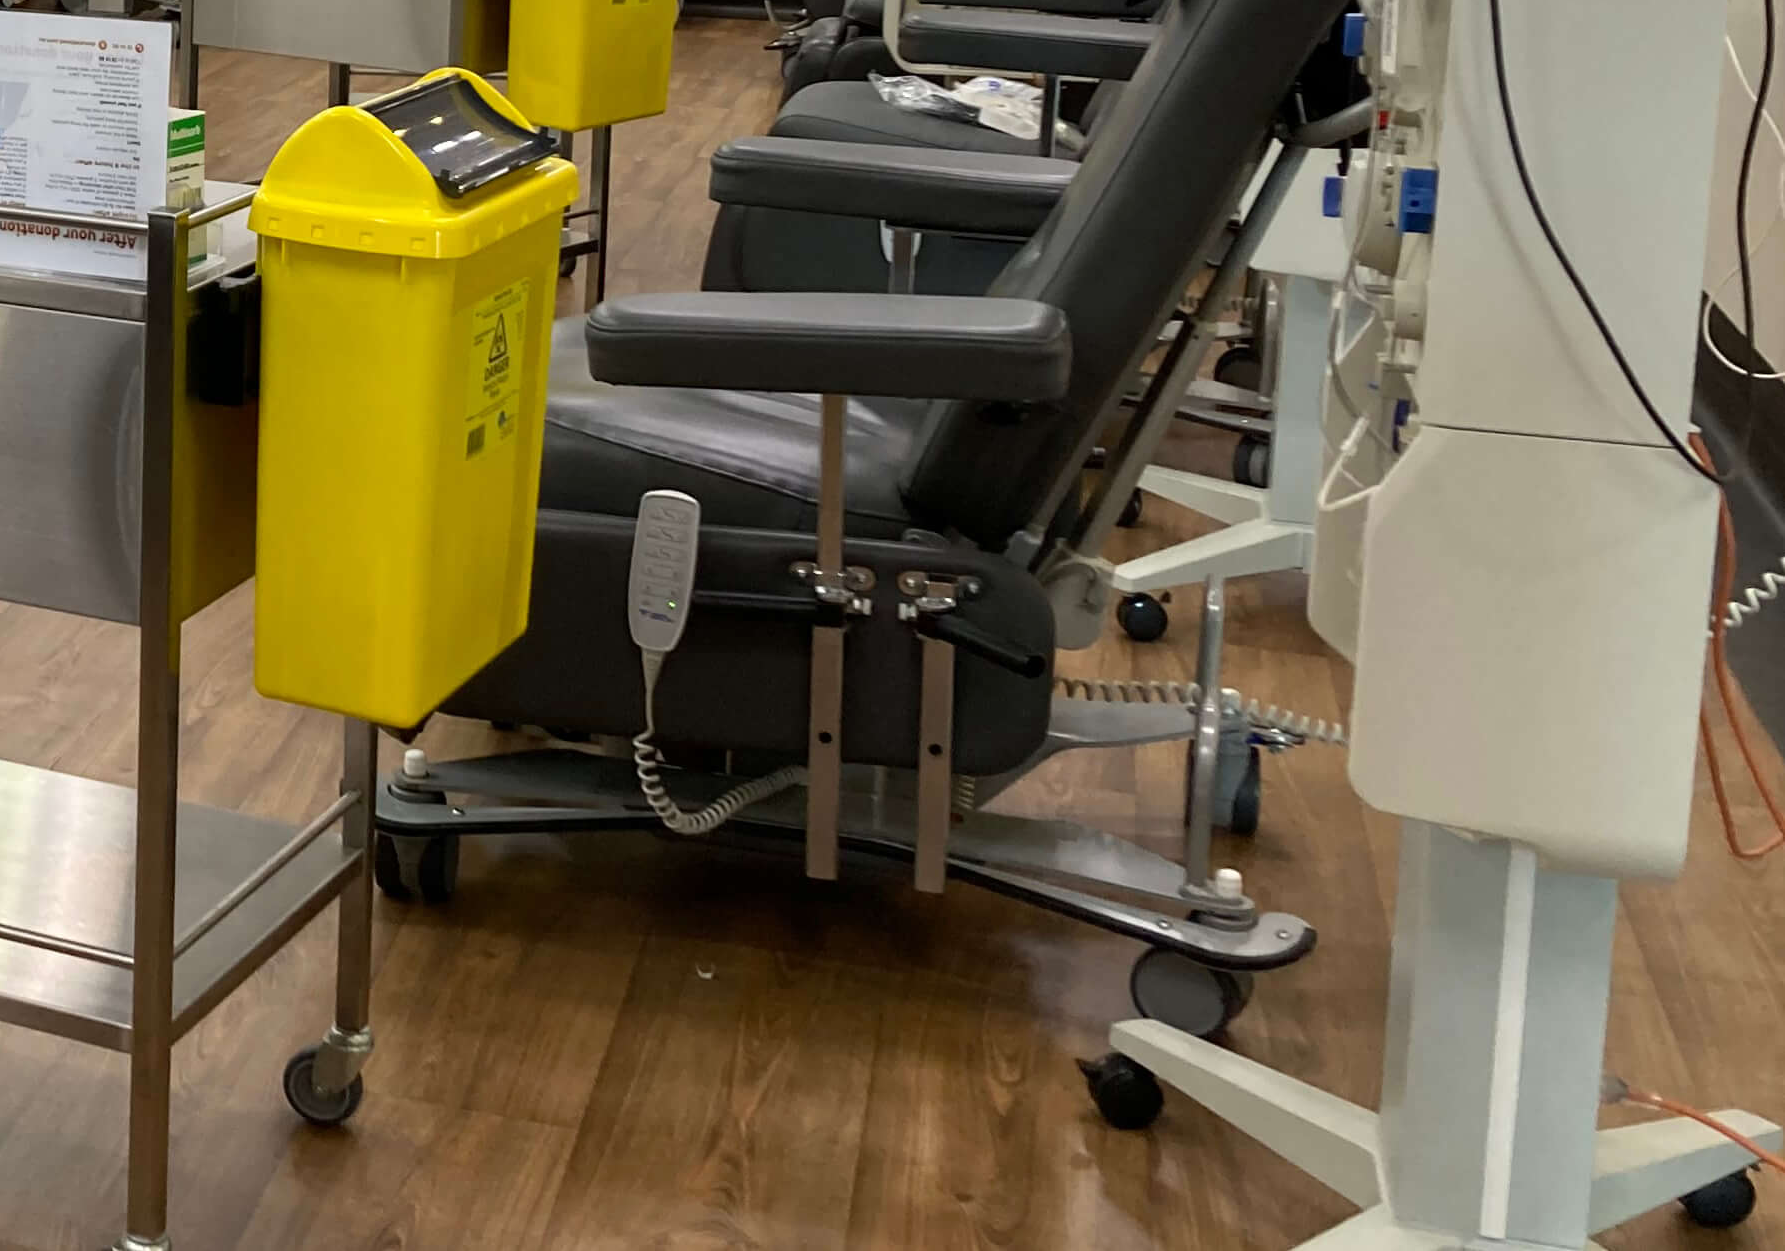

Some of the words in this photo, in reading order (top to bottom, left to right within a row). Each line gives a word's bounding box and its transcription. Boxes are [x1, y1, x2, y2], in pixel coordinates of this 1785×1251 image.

[0, 220, 60, 240] donation
[63, 228, 96, 241] your
[99, 232, 137, 249] After
